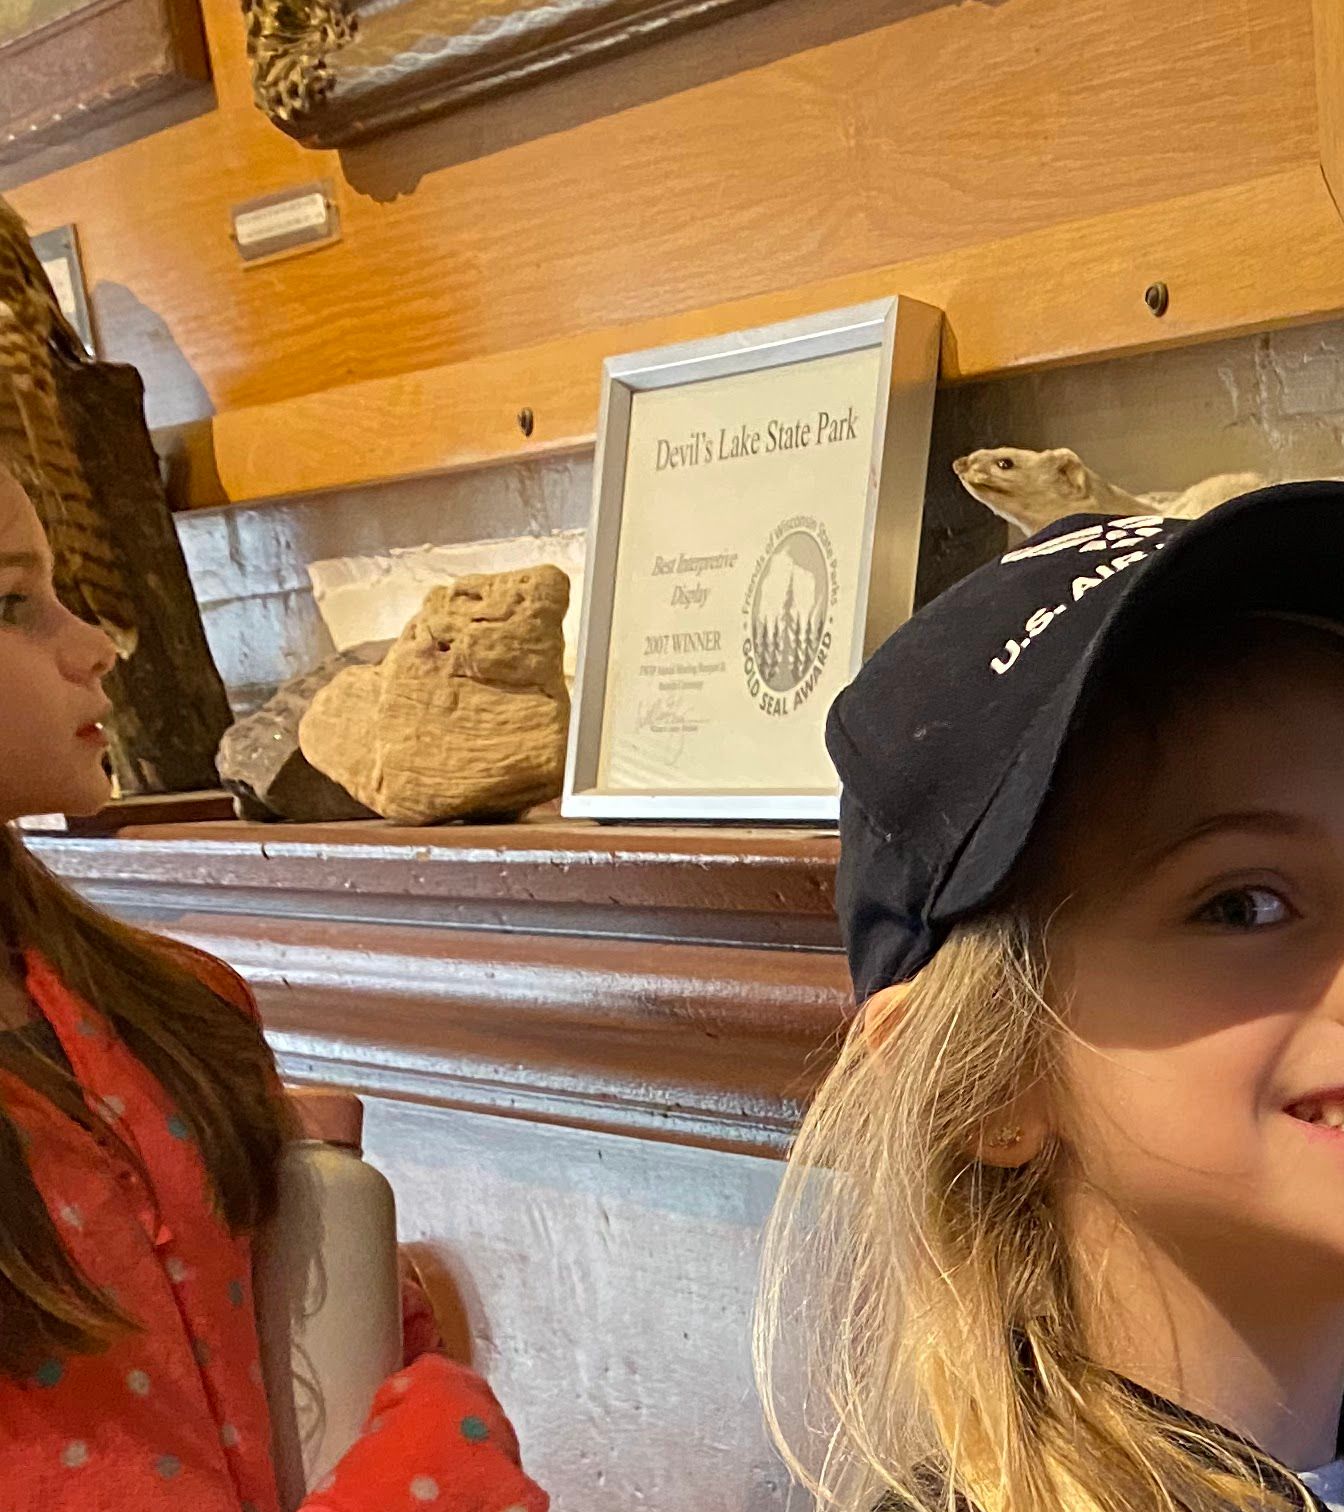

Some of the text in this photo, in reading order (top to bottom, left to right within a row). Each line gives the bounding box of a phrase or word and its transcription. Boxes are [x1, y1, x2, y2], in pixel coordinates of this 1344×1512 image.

[656, 406, 858, 471] Devil's Lake State Park
[672, 631, 721, 653] WINNER
[991, 605, 1067, 674] U.S.
[743, 632, 832, 716] GOLD SEAL AWARD
